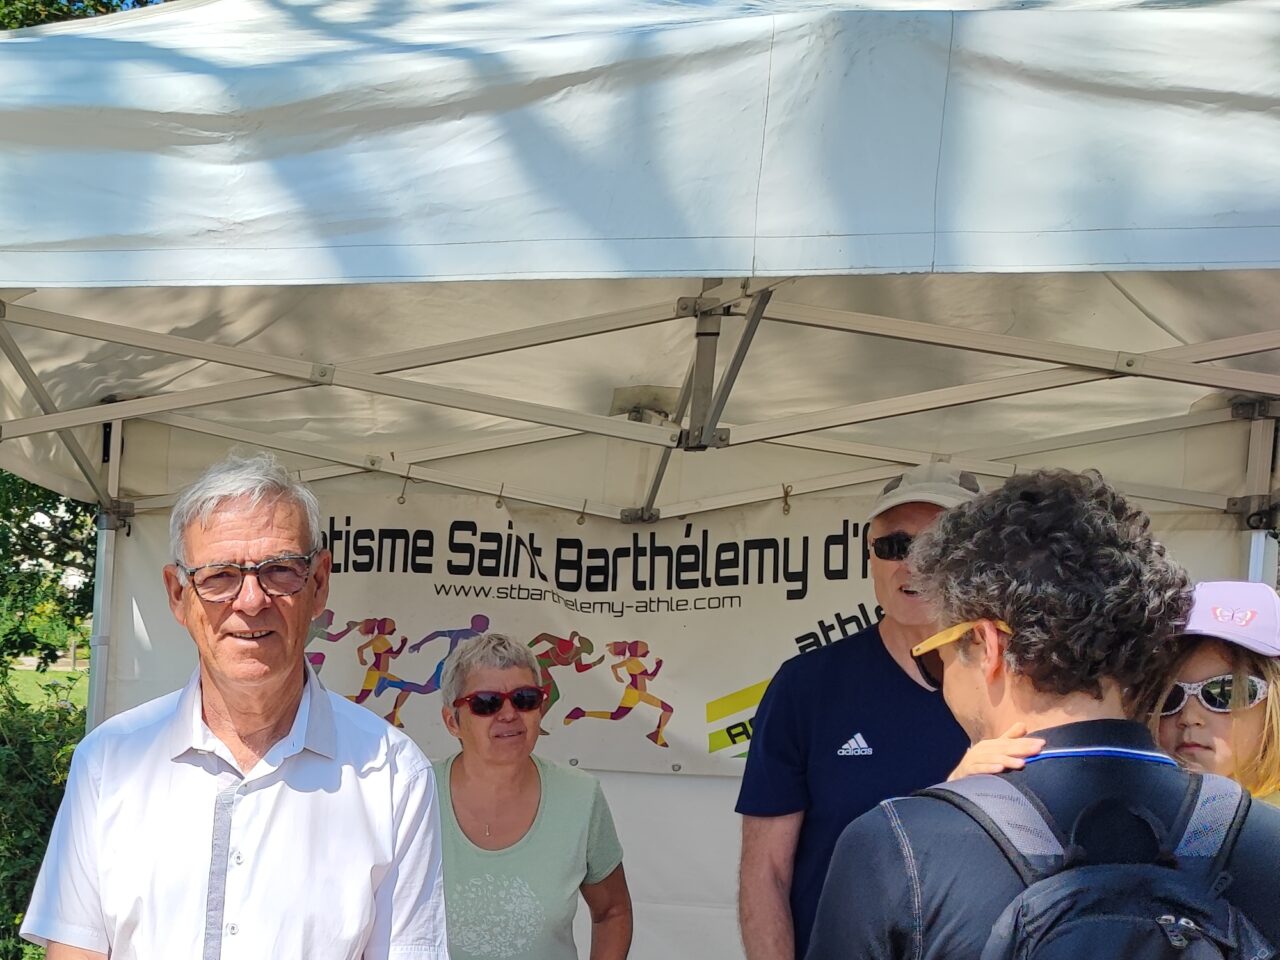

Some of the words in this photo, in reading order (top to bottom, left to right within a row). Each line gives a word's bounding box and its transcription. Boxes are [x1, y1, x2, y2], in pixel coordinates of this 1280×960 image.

[322, 516, 434, 573] tisme
[447, 520, 548, 582] Saint
[555, 523, 809, 600] Barthélemy
[434, 583, 741, 617] www.stbarthelemy-athle.com
[837, 747, 873, 756] adidas
